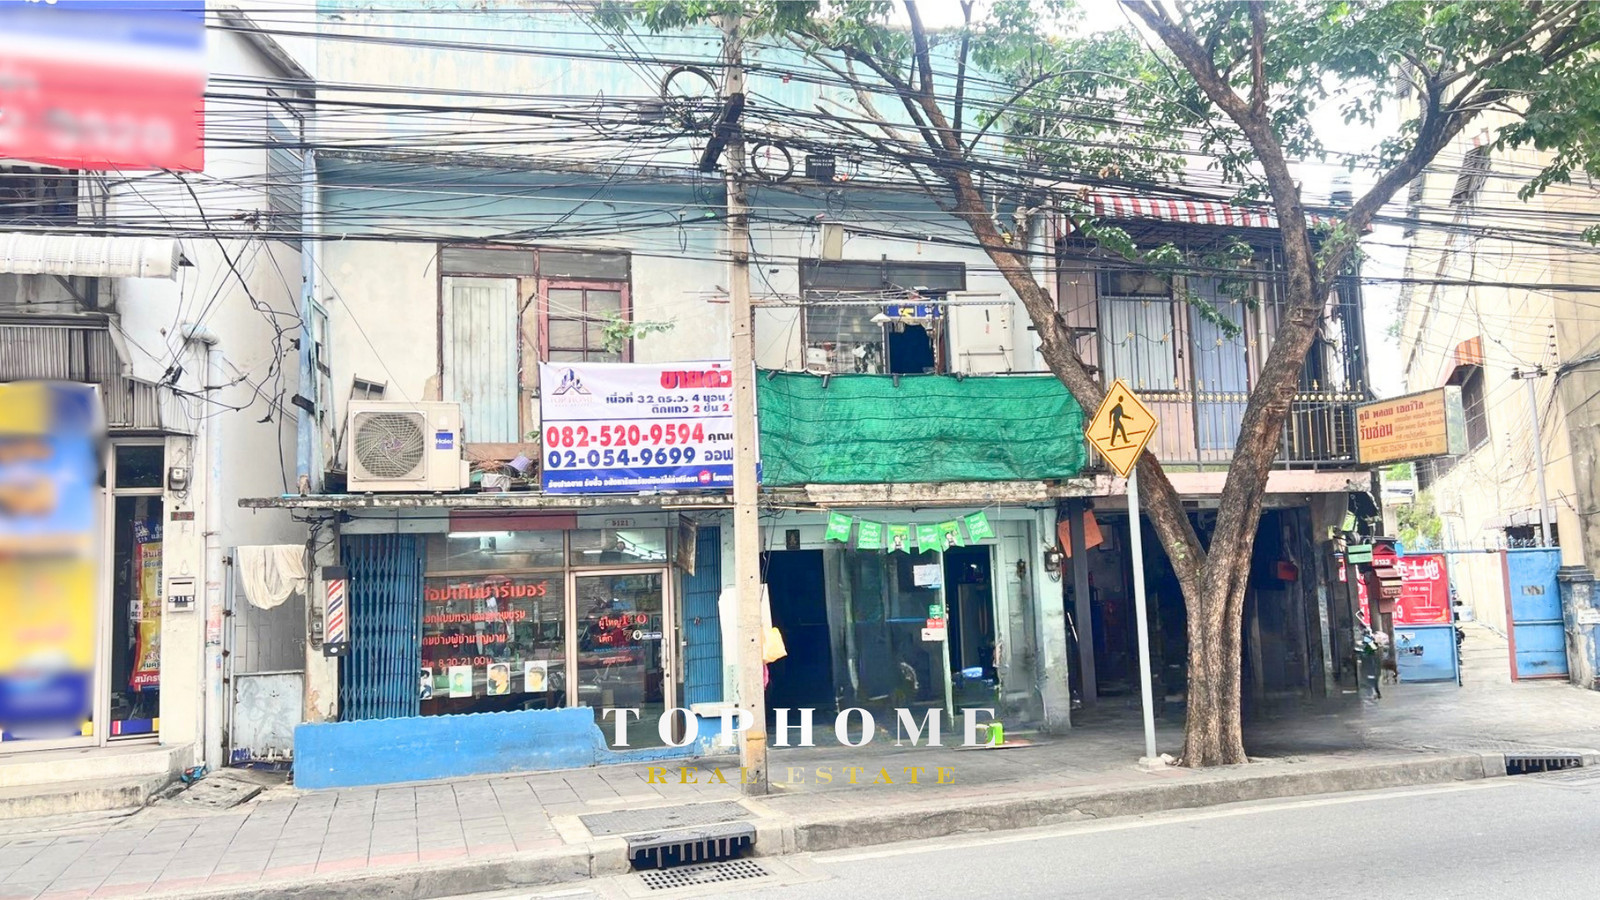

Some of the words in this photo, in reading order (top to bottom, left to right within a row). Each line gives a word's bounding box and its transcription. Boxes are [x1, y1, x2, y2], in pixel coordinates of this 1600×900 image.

[660, 363, 733, 389] ขายด่ว
[637, 394, 654, 403] 32
[692, 394, 700, 402] 4
[693, 404, 700, 412] 2
[722, 403, 730, 412] 2
[546, 422, 705, 448] 082-520-9594
[708, 432, 733, 444] คุณ
[548, 446, 696, 468] 02-054-9699
[704, 447, 733, 462] ออฟ
[423, 633, 506, 648] ดยช่างผู้ชำนาญงาน
